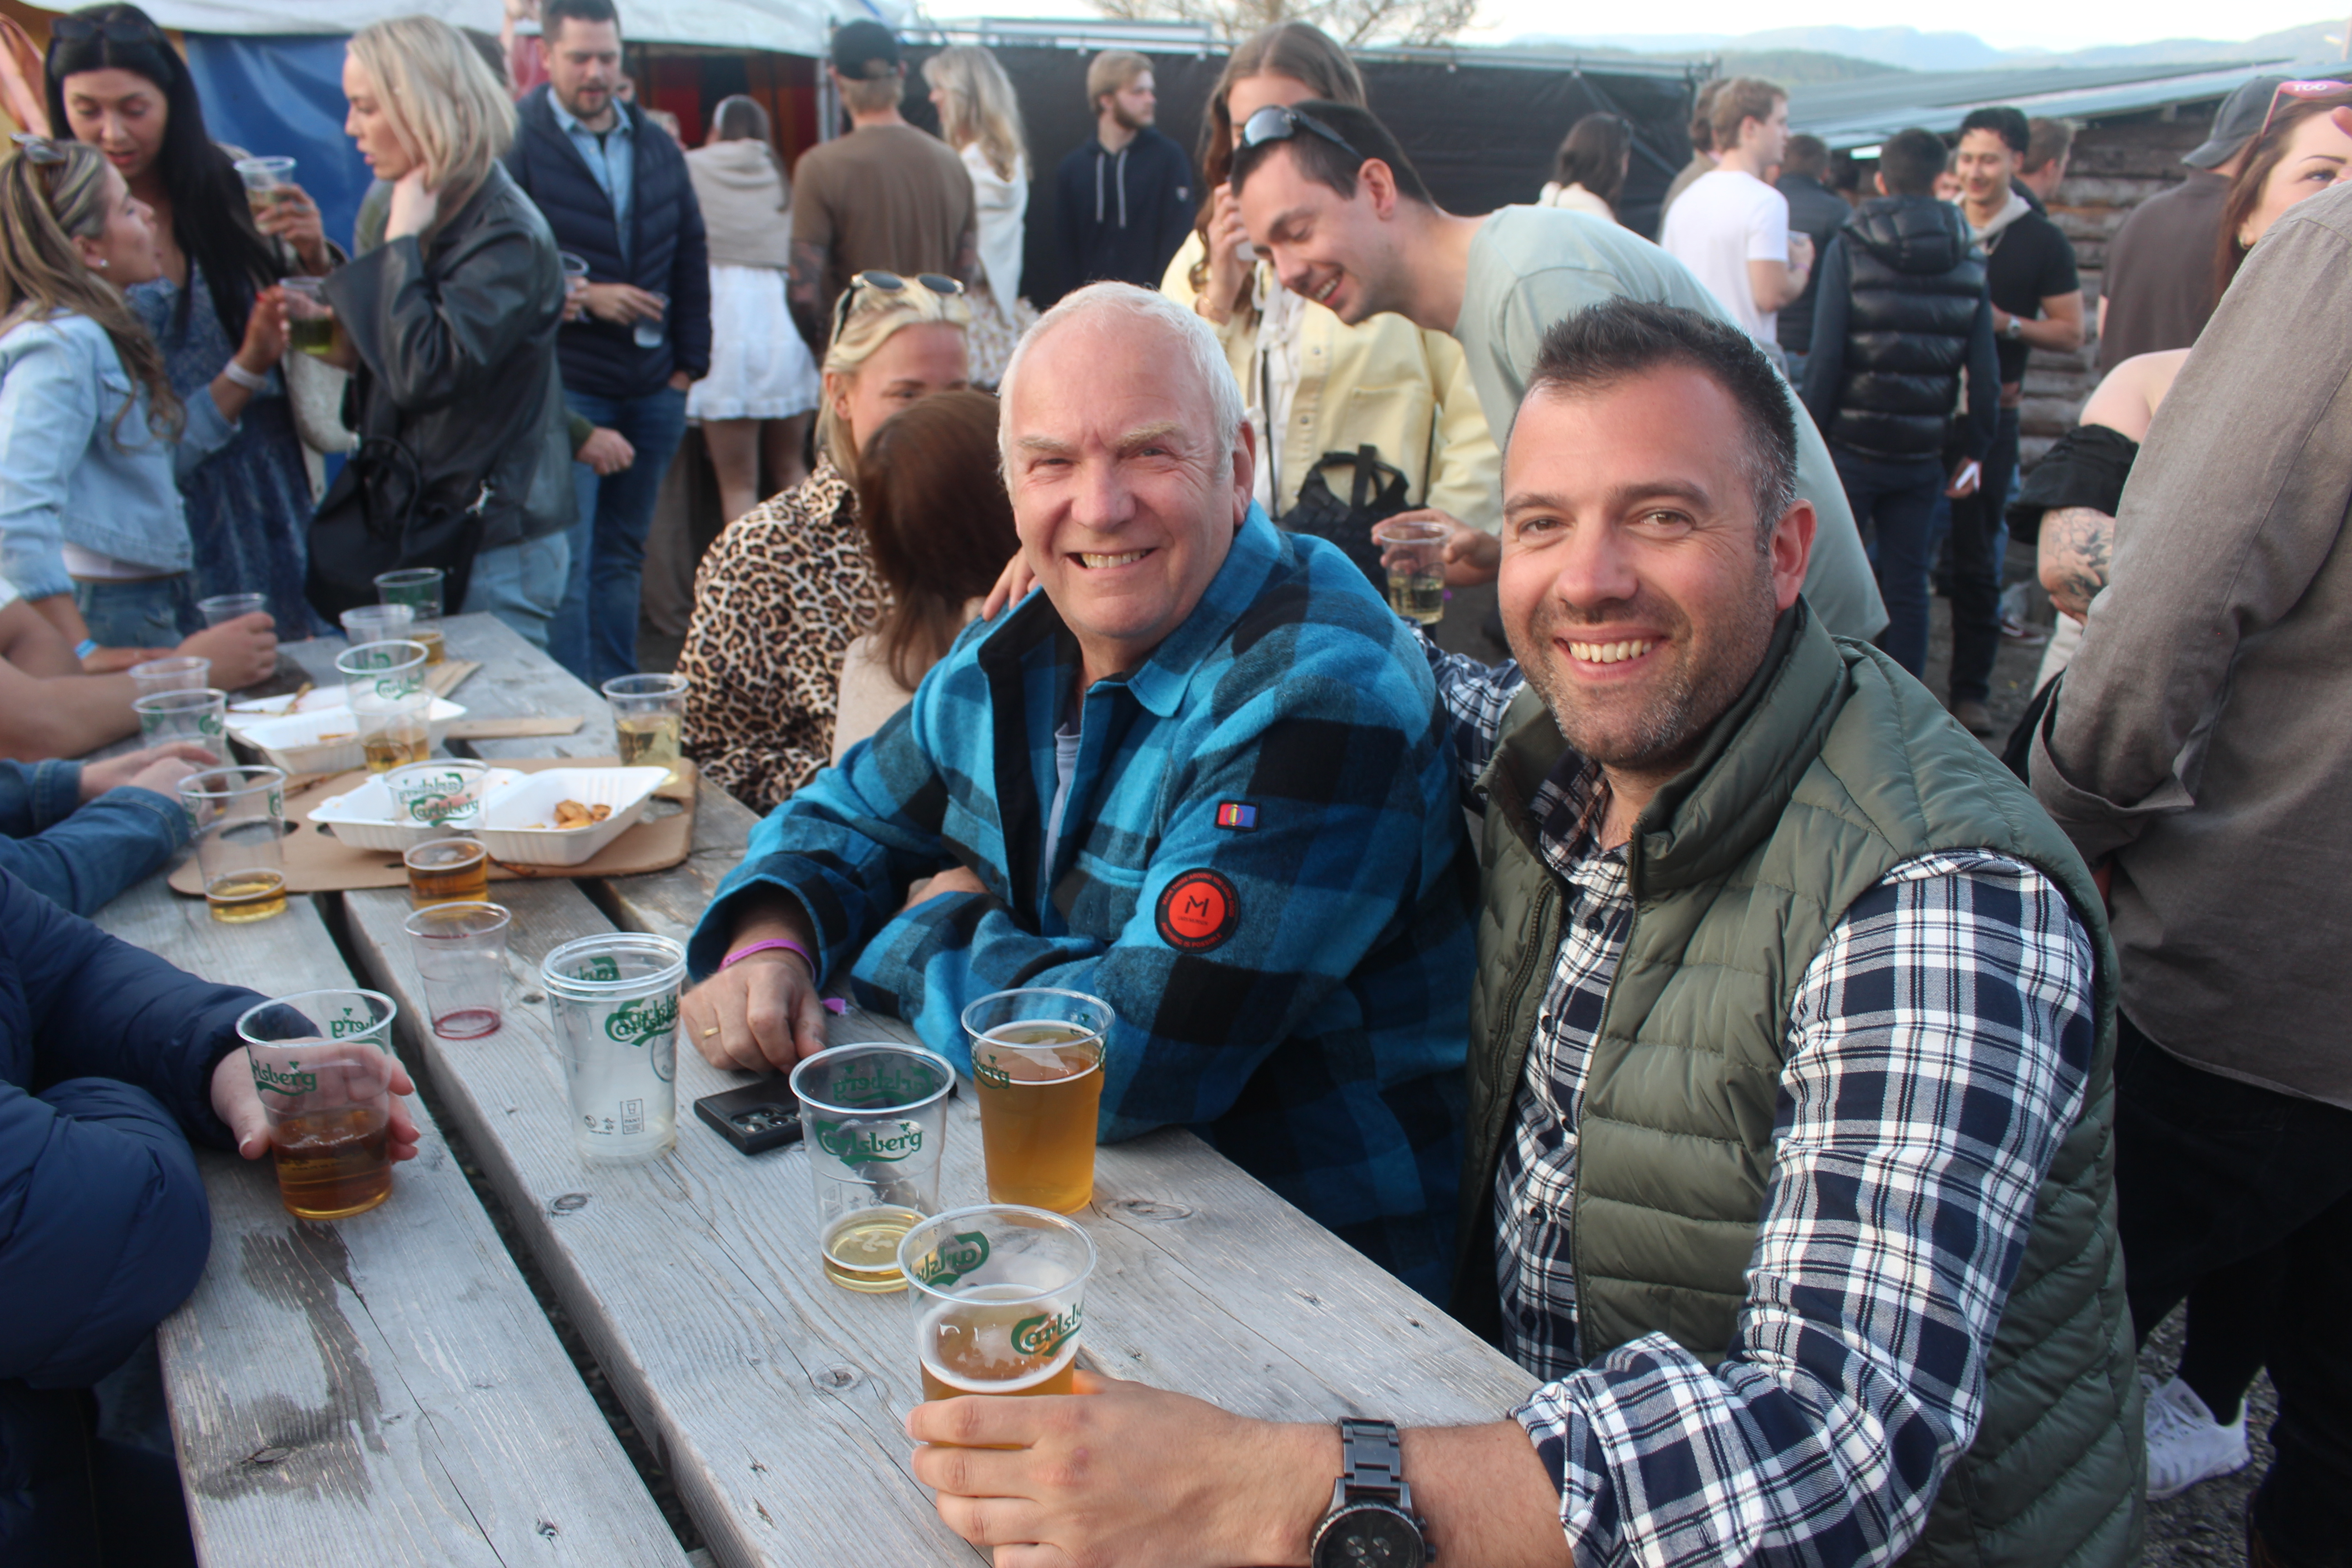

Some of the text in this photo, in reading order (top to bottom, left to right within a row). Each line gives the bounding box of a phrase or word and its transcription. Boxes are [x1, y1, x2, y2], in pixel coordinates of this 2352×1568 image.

[410, 794, 479, 822] Carlsberg
[251, 1058, 317, 1093] rlsberg
[816, 1120, 923, 1158] Carlsberg
[1011, 1303, 1082, 1356] Carlsb
